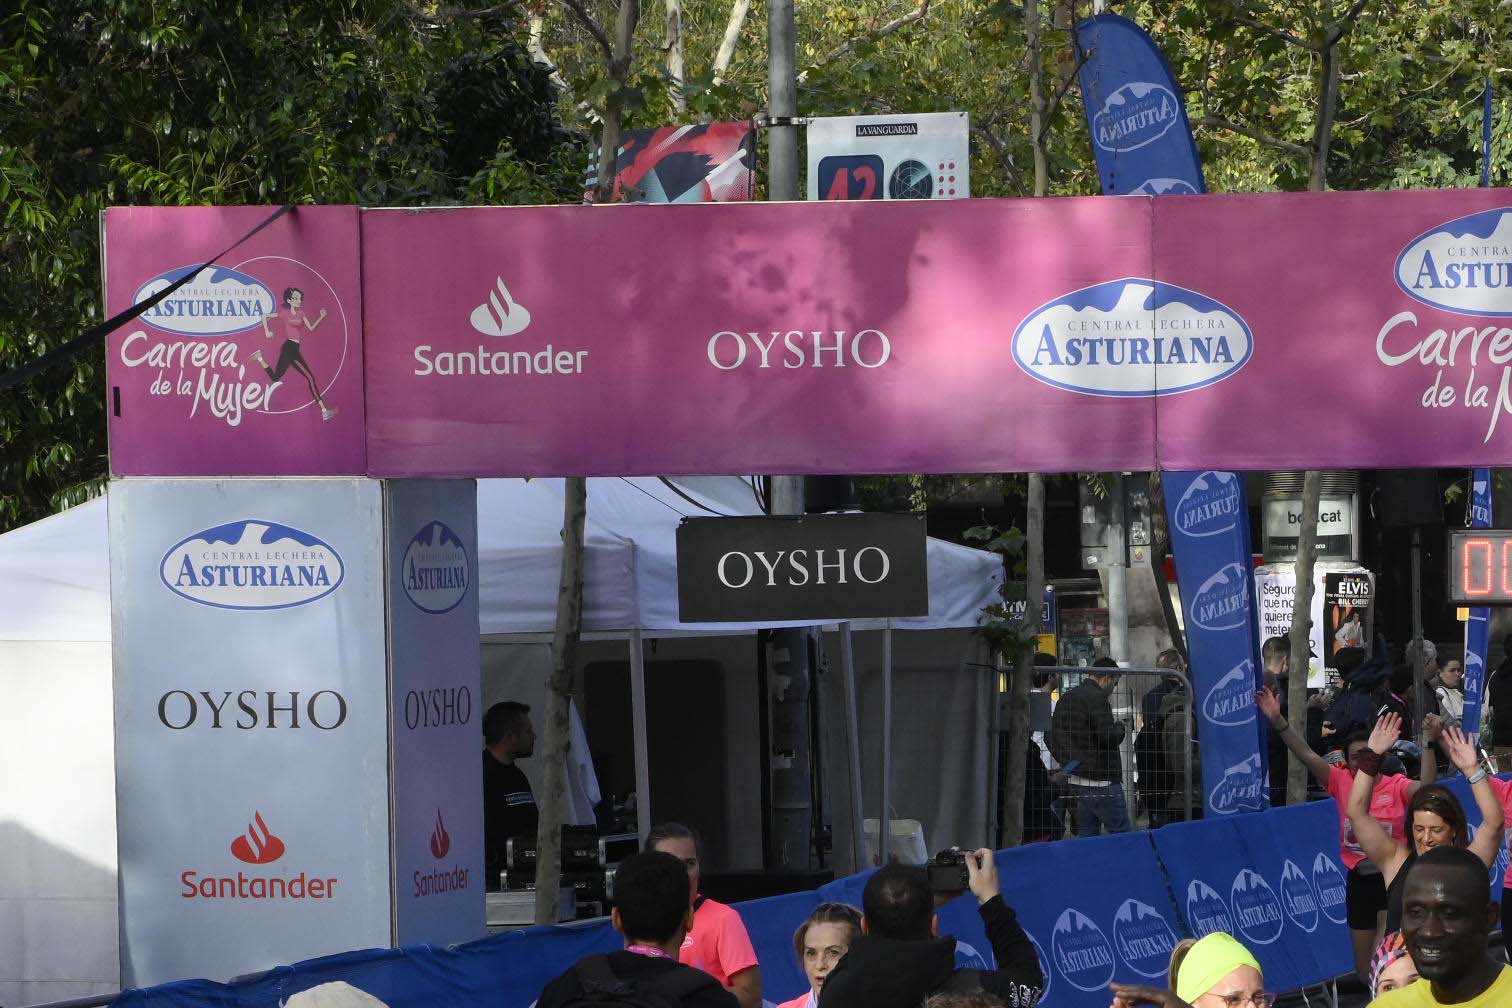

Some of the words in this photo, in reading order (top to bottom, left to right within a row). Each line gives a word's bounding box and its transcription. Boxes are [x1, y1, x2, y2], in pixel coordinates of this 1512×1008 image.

[172, 288, 210, 296] ENTRAL
[1067, 321, 1143, 332] CENTRAL
[1152, 318, 1226, 330] LECHERA
[121, 331, 236, 370] Carrera
[414, 344, 588, 375] Santander
[706, 329, 891, 370] OYSHO
[1031, 323, 1235, 366] ASTURIANA
[150, 376, 172, 395] de
[176, 374, 192, 396] la
[189, 365, 283, 426] Mujer
[1421, 367, 1457, 408] de
[1464, 367, 1488, 408] la
[175, 554, 331, 588] ASTURIANA
[202, 552, 261, 560] CENTRAL
[266, 552, 324, 560] LECHERA
[717, 547, 890, 588] OYSHO
[407, 556, 465, 592] ASTURIANA
[1339, 582, 1368, 594] ELVIS
[1264, 598, 1281, 609] que
[158, 690, 347, 730] OYSHO
[405, 686, 471, 730] OYSHO
[181, 871, 338, 899] Santander
[414, 866, 469, 897] Santander
[1059, 941, 1112, 974] ASTURIANA
